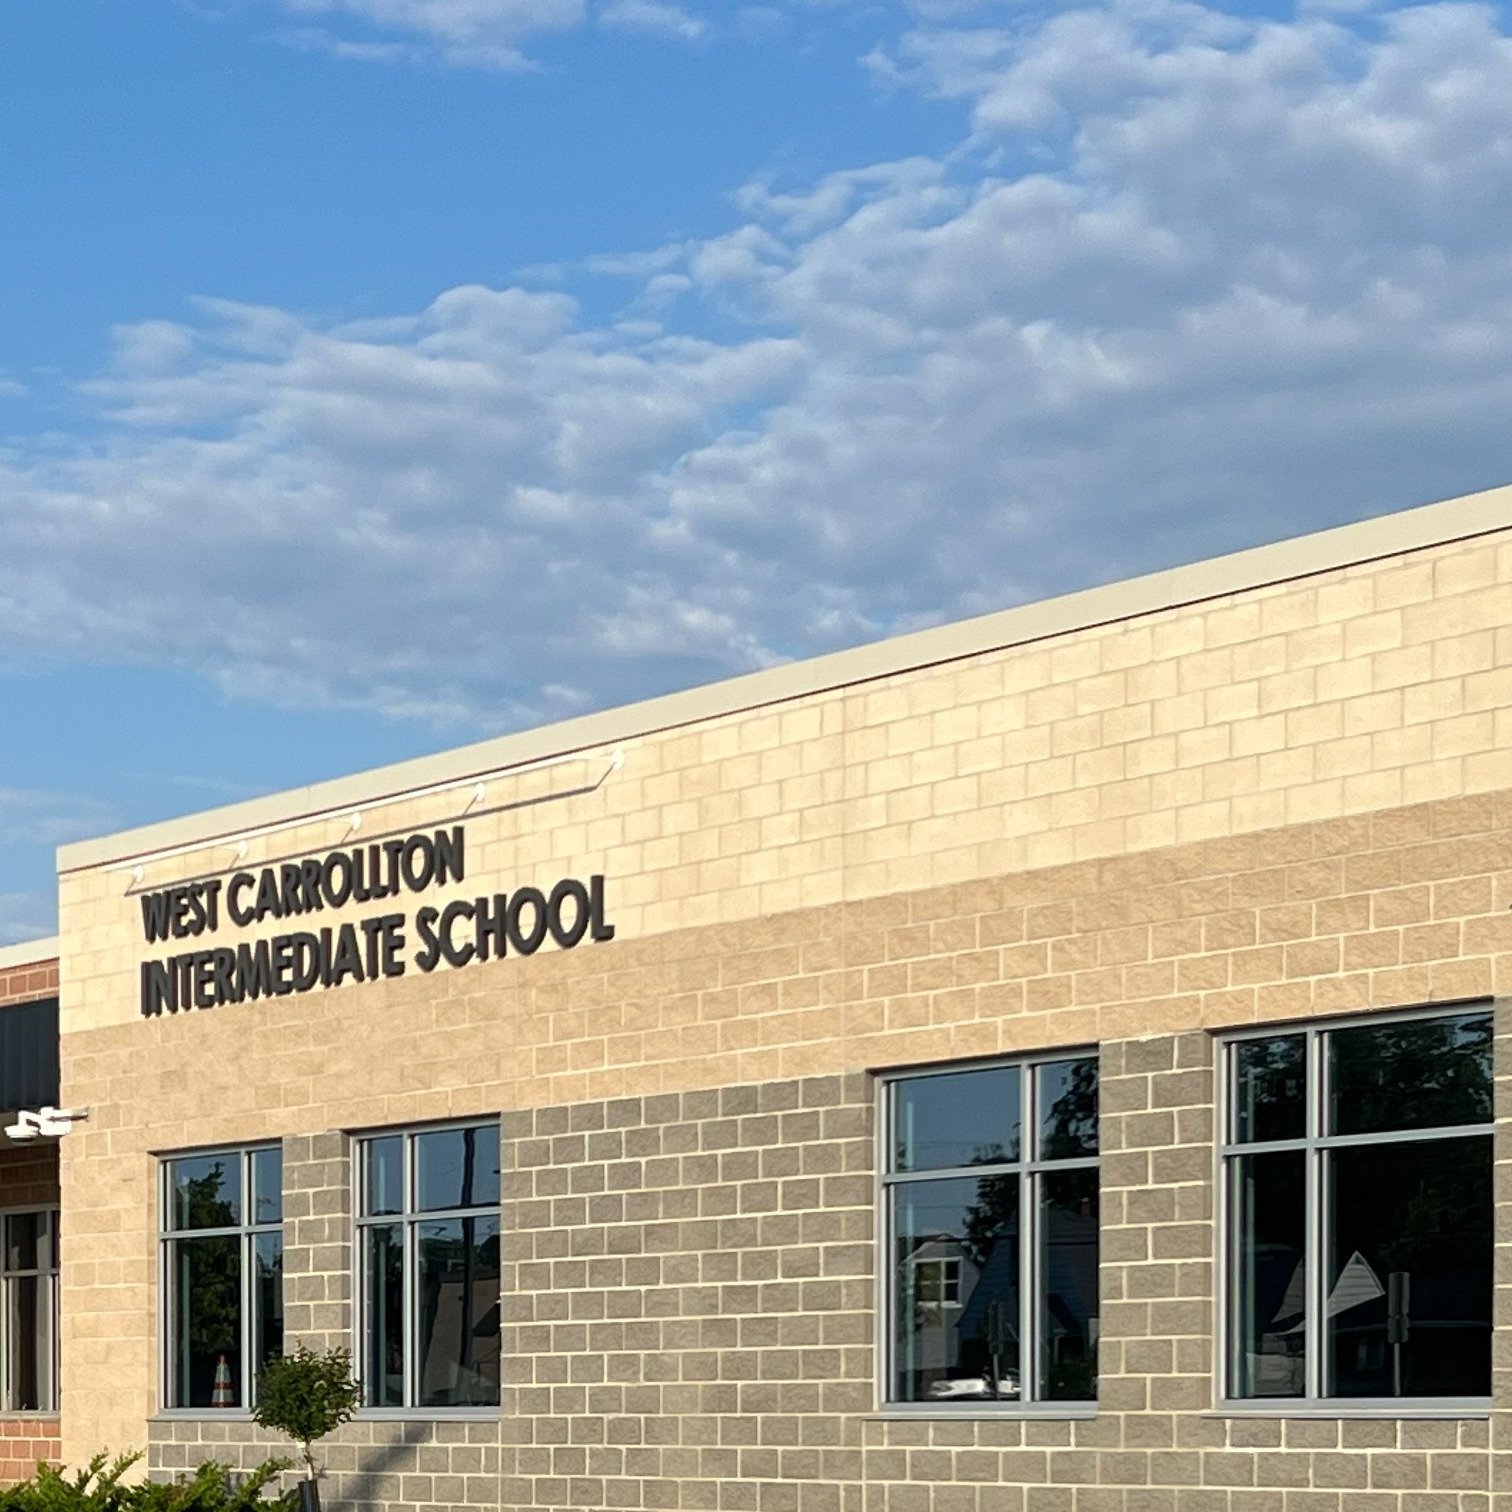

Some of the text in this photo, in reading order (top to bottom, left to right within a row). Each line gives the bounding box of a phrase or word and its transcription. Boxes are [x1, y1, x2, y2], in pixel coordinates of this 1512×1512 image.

[141, 826, 465, 943] WEST CARROLLTON
[141, 875, 615, 1018] INTERMEDIATE SCHOOL
